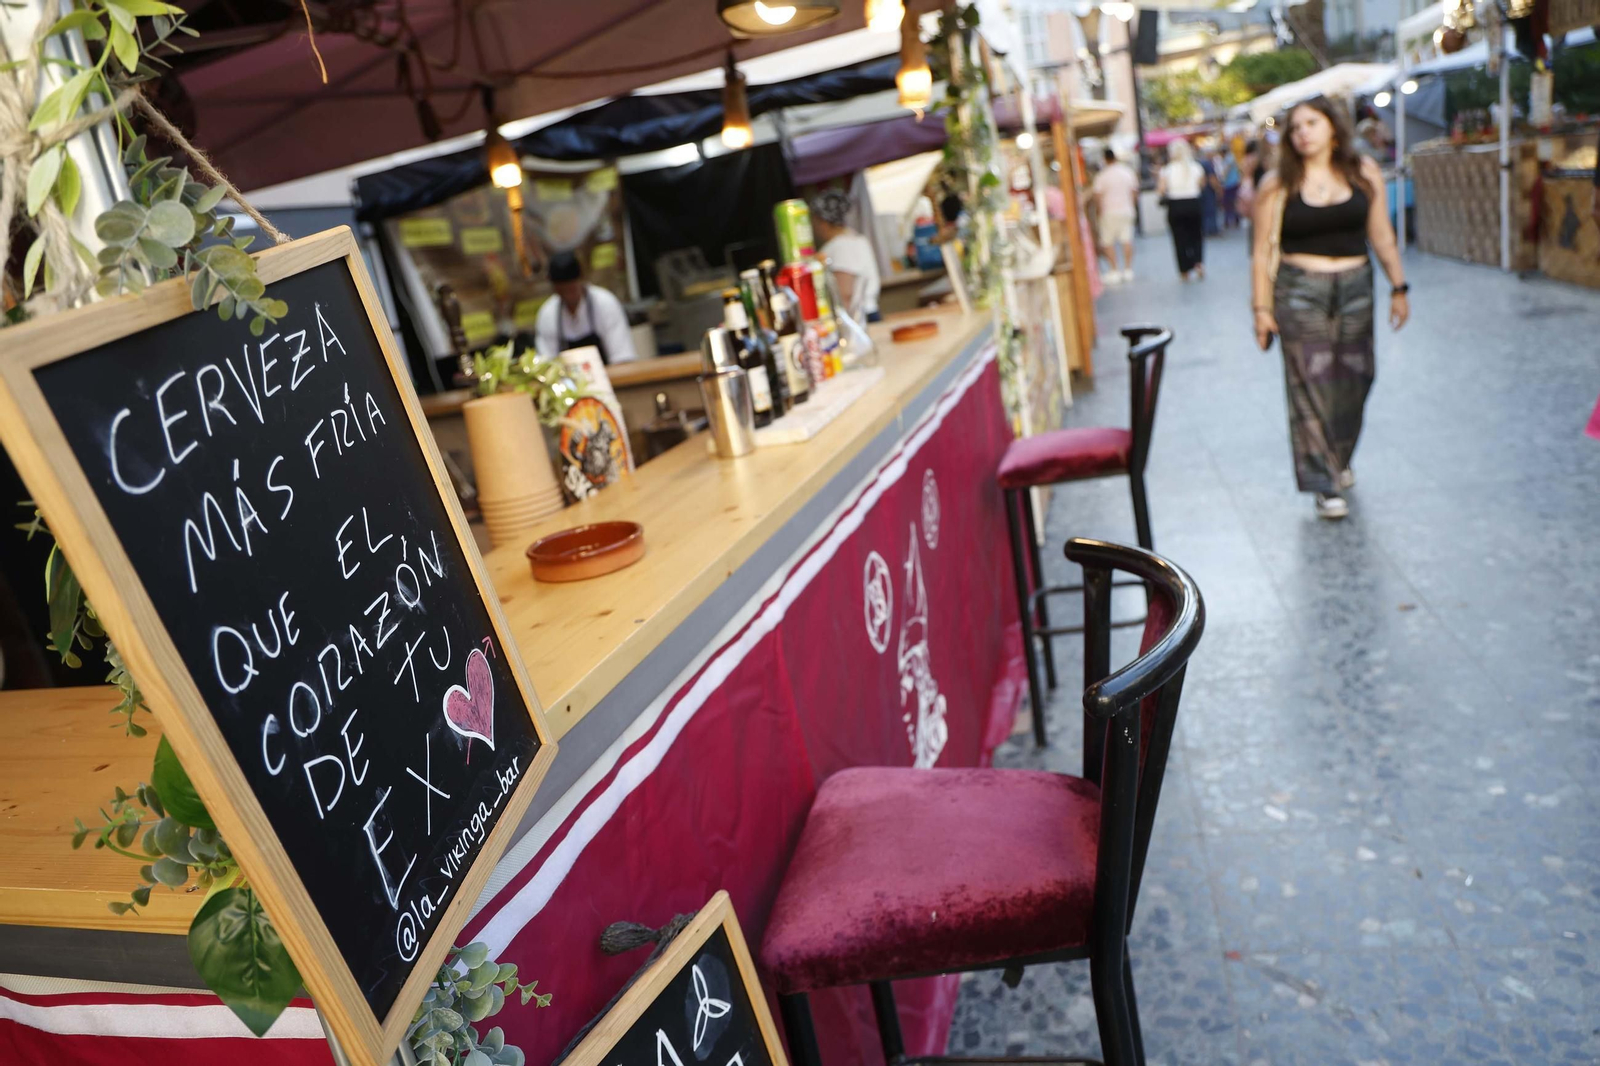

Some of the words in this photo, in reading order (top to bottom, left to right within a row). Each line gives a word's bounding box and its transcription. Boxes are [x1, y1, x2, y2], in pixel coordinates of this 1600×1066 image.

[109, 302, 347, 494] CERVEZA
[184, 455, 294, 593] MÁS
[305, 382, 386, 478] FRÍA
[213, 590, 300, 694] QUE
[336, 506, 394, 579] EL
[263, 530, 443, 776] CORAZÓN
[303, 708, 370, 819] DE
[394, 625, 451, 702] TU
